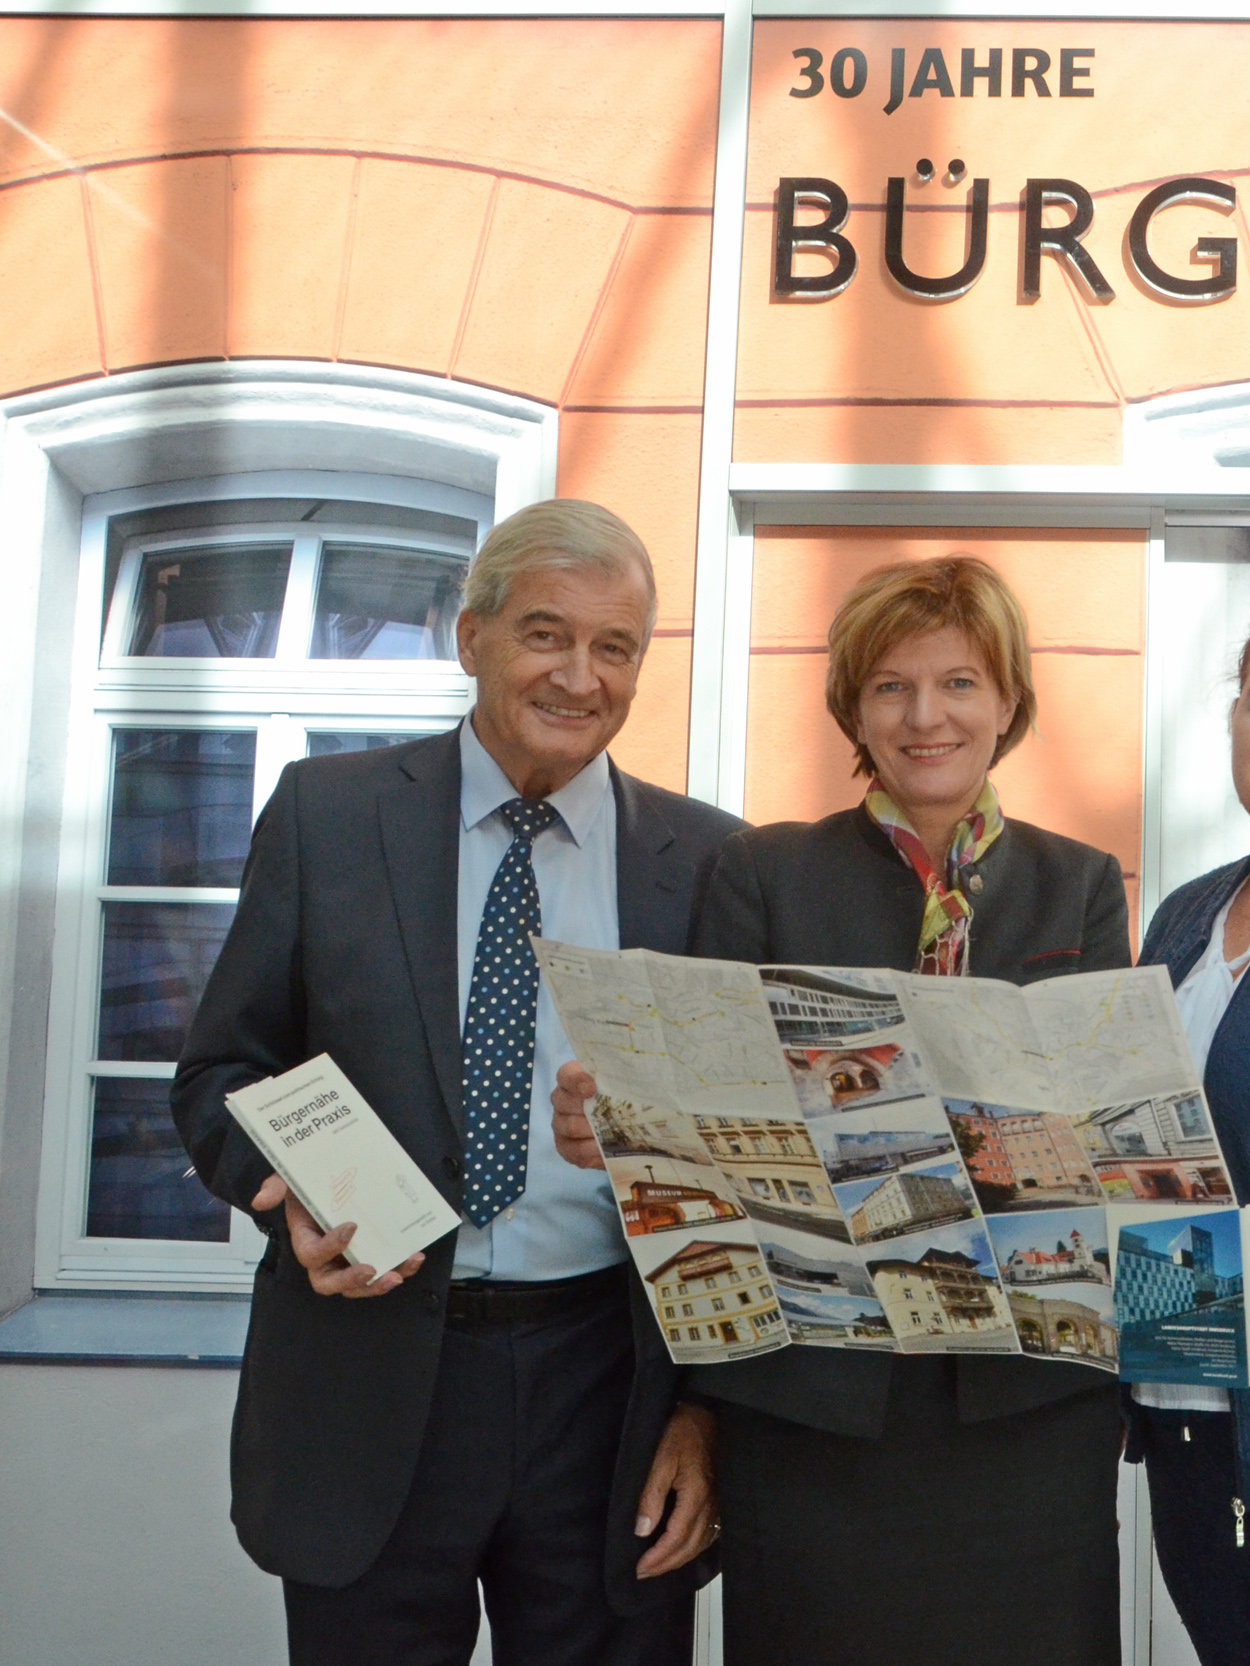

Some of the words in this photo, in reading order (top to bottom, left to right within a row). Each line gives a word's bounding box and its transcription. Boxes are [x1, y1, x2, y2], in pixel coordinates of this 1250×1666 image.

[788, 46, 868, 99] 30
[882, 47, 1096, 116] JAHRE
[268, 1088, 339, 1132] Bürgernähe
[280, 1134, 292, 1148] in
[295, 1124, 315, 1142] der
[314, 1103, 352, 1130] Praxis
